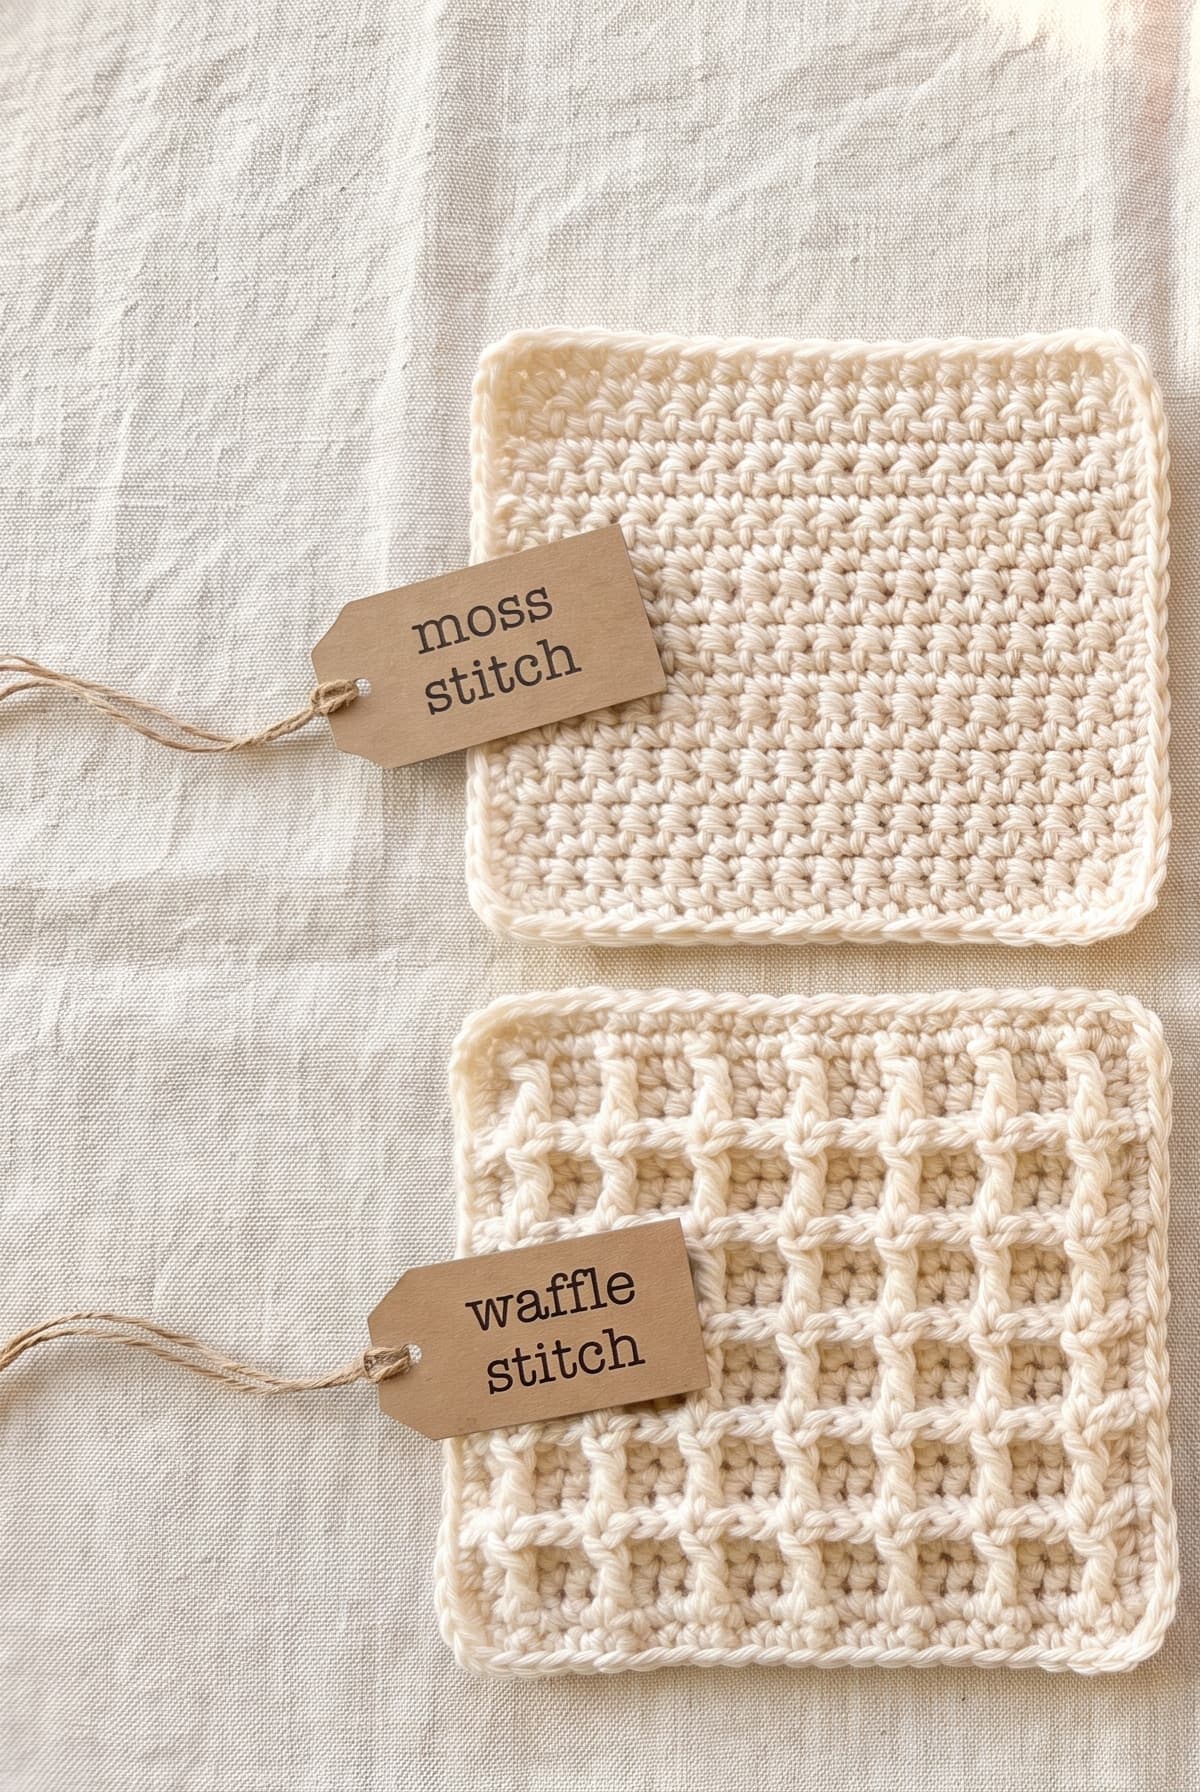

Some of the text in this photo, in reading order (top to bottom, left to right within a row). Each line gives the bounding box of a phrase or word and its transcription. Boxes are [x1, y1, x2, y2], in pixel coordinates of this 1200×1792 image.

[412, 586, 553, 655] moss
[425, 638, 582, 716] stitch
[464, 1266, 636, 1332] waffle
[486, 1327, 646, 1395] stitch
